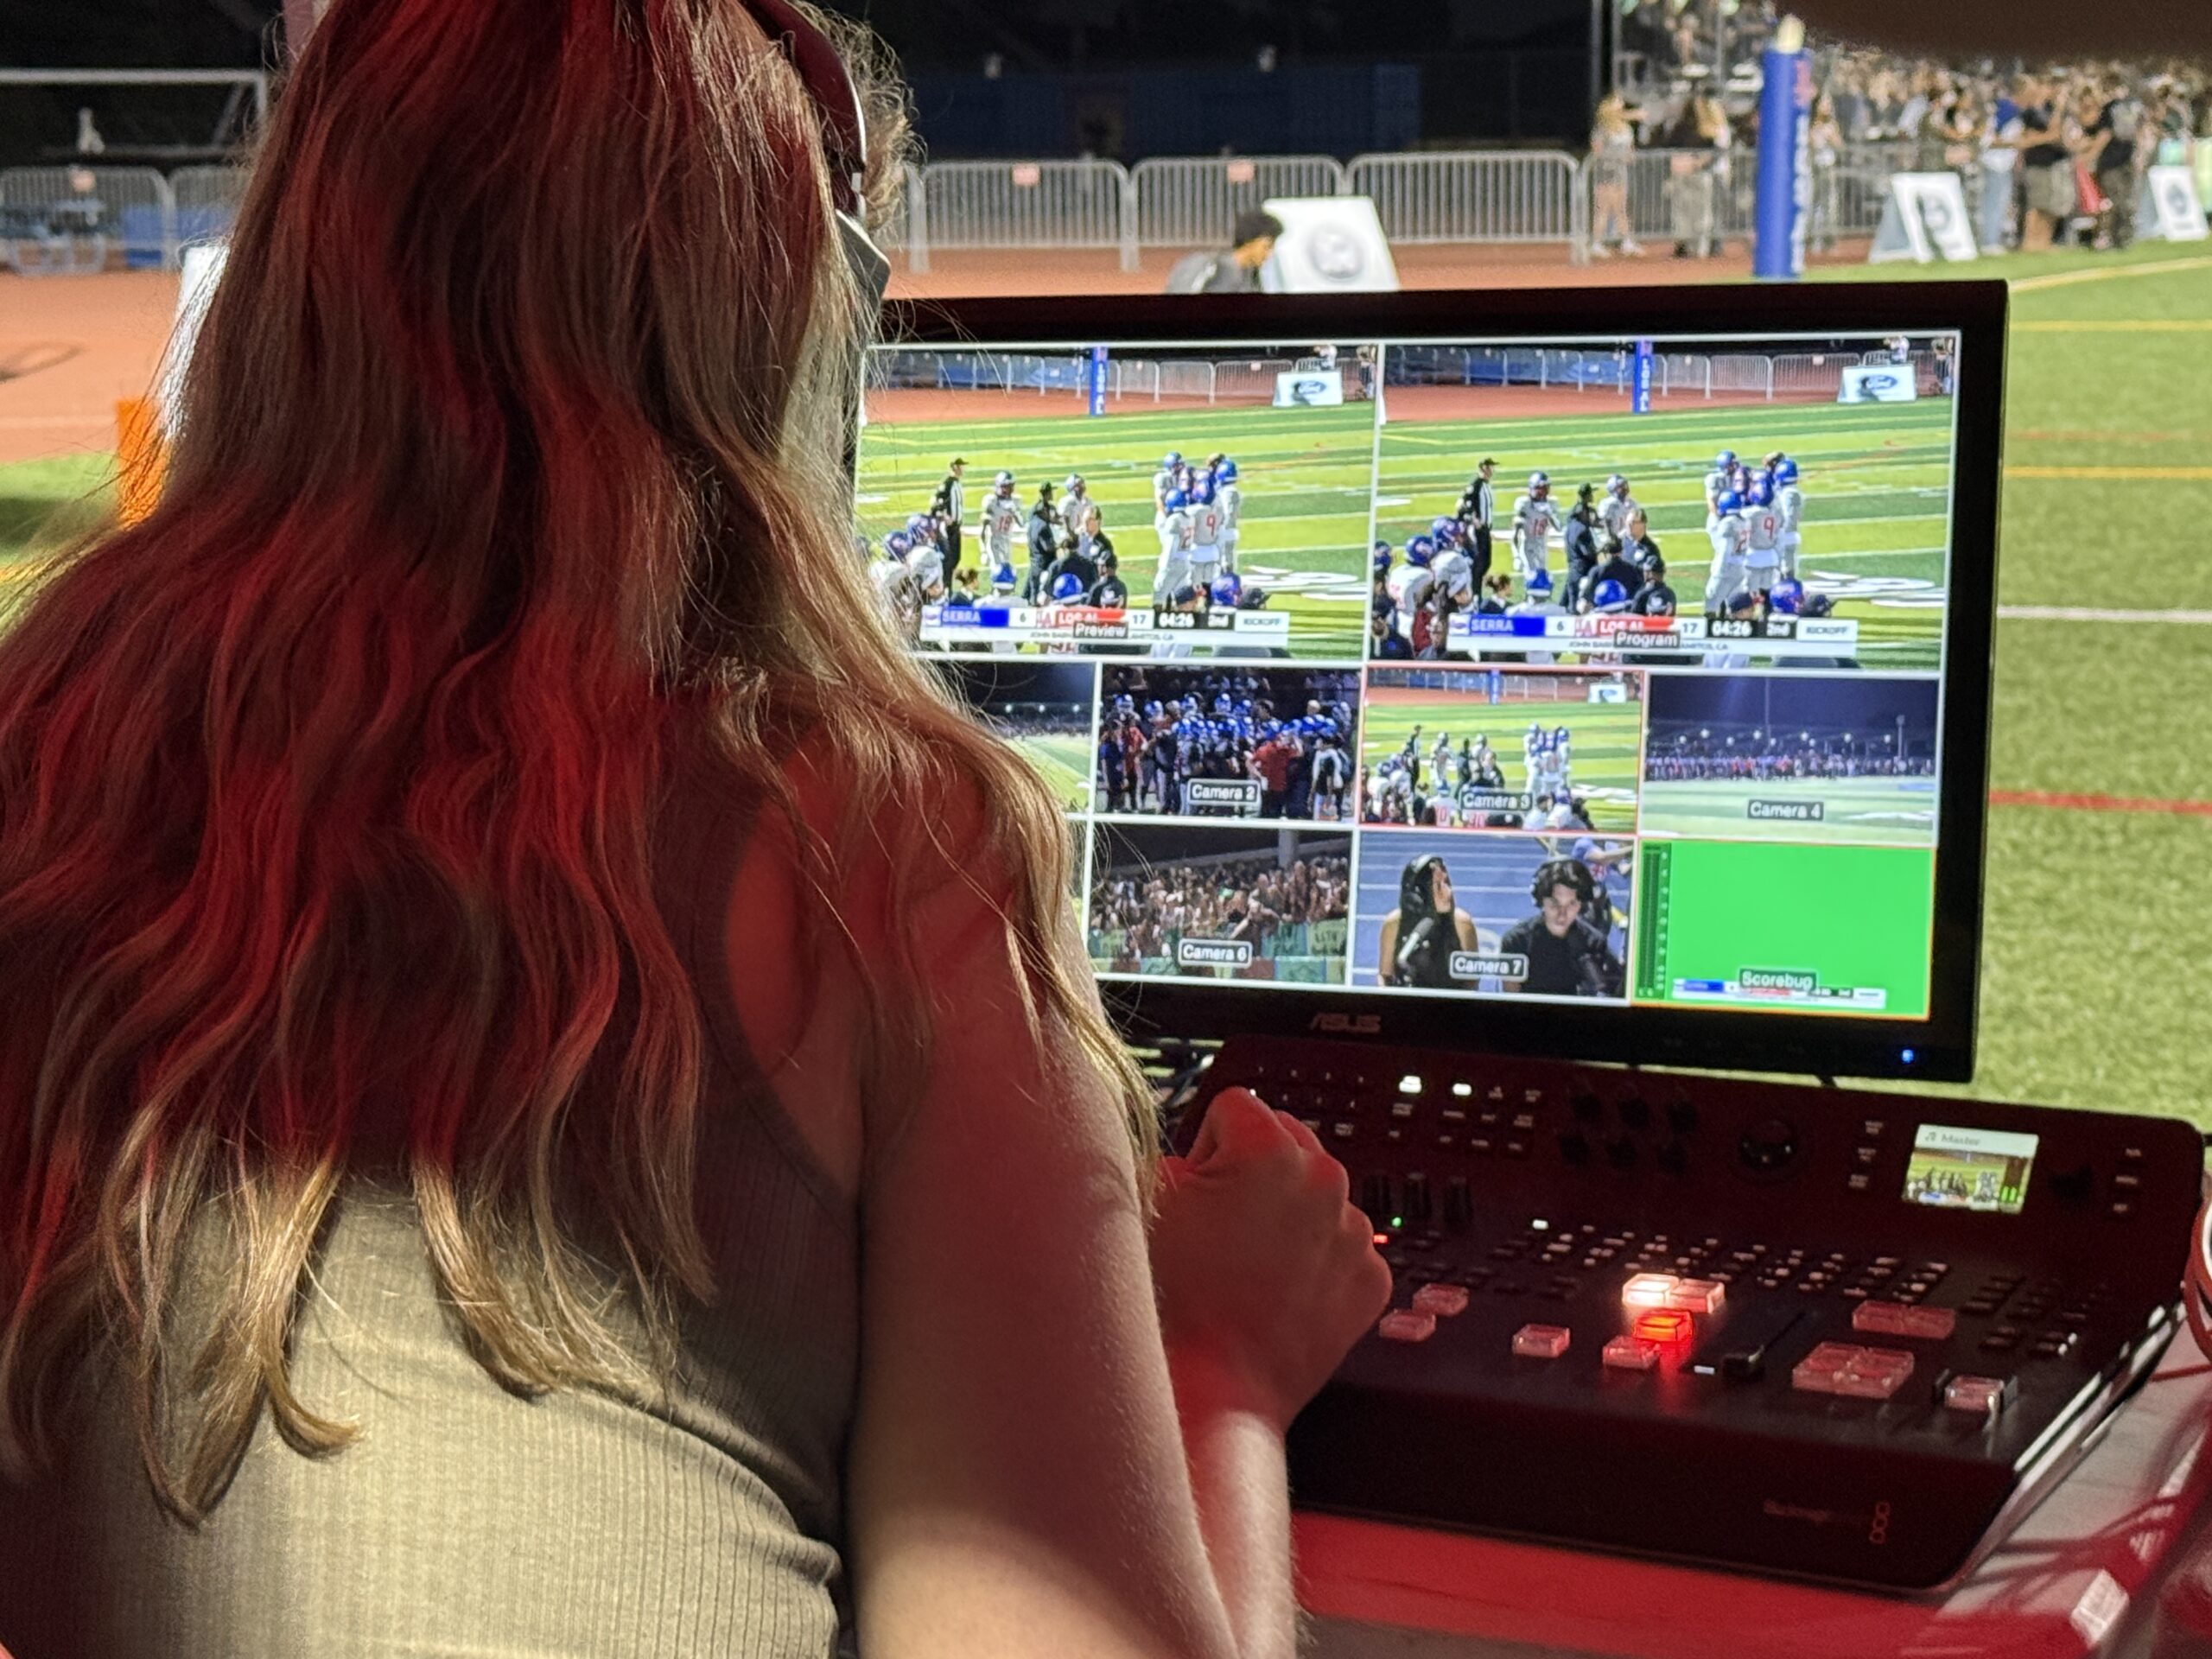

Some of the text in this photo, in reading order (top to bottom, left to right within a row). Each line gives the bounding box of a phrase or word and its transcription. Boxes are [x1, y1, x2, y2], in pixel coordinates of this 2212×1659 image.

[942, 610, 981, 623] SERRA
[1019, 613, 1027, 623] 6
[1132, 614, 1147, 625] 17
[1075, 622, 1125, 637] Preview
[1471, 619, 1514, 632] SERRA
[1556, 620, 1564, 632] 6
[1681, 622, 1698, 633] 17
[1712, 620, 1752, 637] 04:26
[1766, 621, 1789, 637] 2nd
[1617, 631, 1678, 648] Program
[1192, 784, 1255, 800] Camera 2
[1463, 793, 1518, 809] Camera
[1751, 801, 1821, 818] Camera 4
[1183, 944, 1247, 962] Camera 6
[1454, 957, 1522, 975] Camera 7
[1742, 969, 1814, 990] Scorebug
[1941, 1134, 1980, 1146] Master
